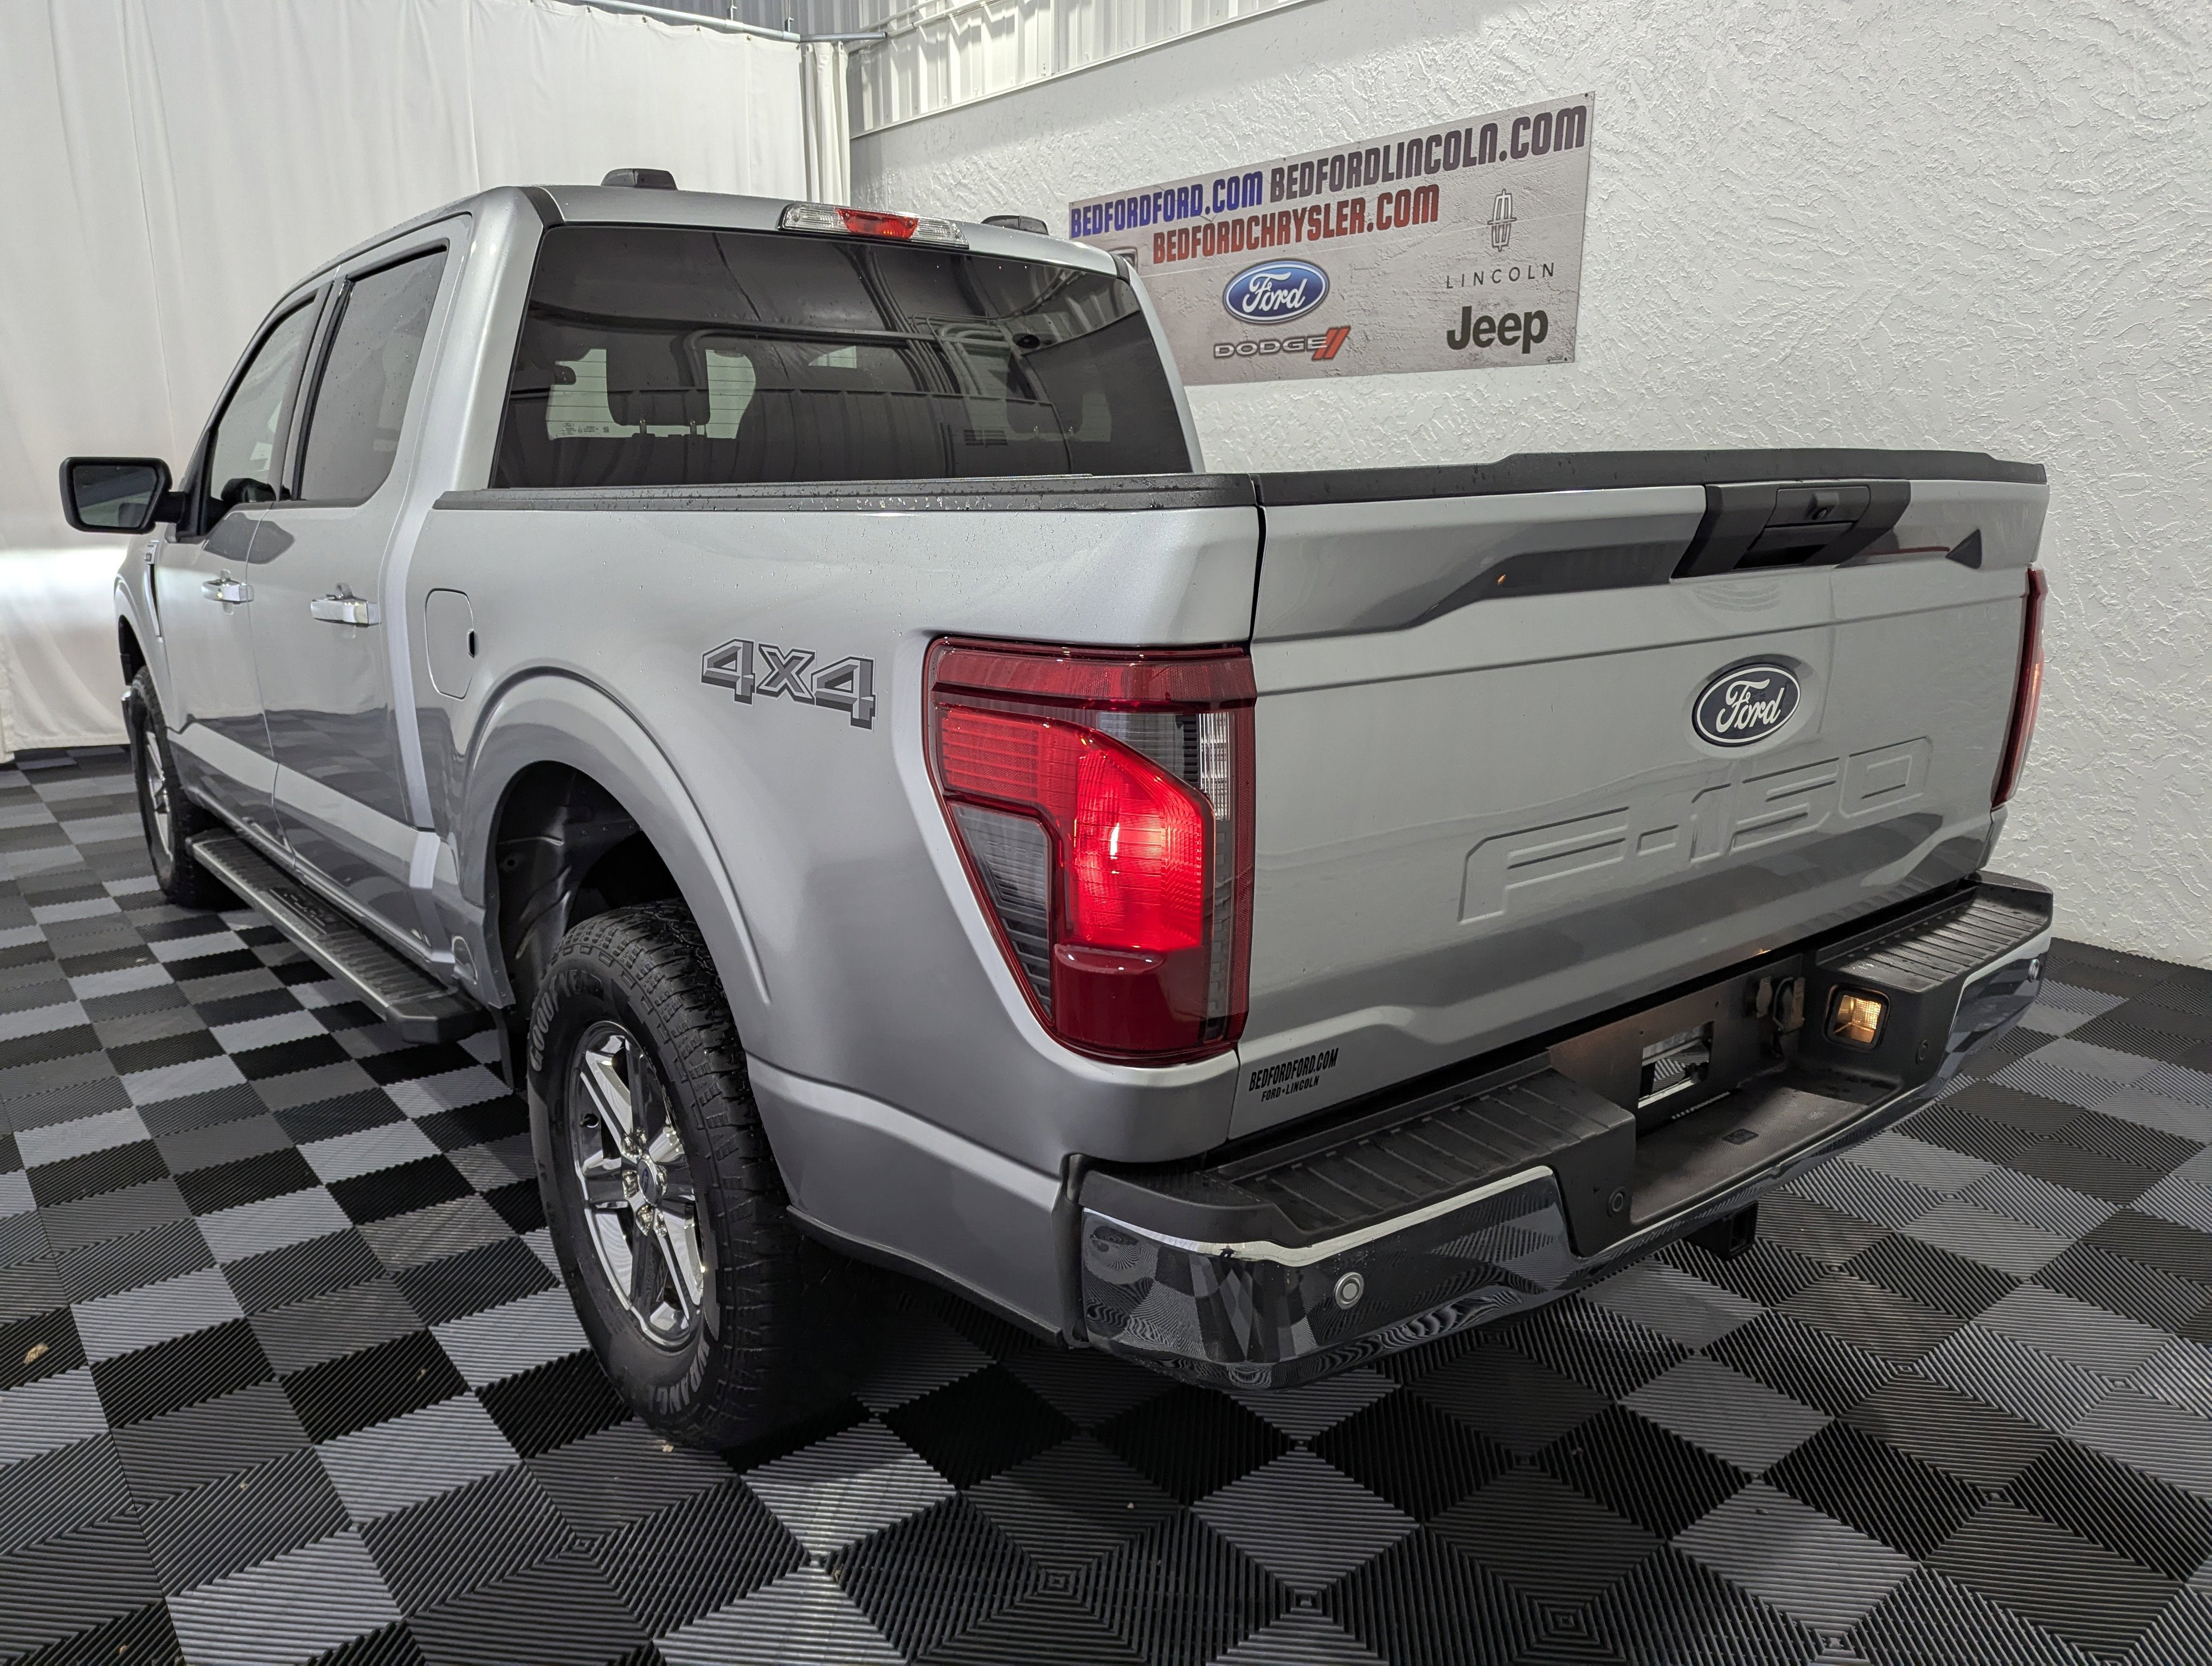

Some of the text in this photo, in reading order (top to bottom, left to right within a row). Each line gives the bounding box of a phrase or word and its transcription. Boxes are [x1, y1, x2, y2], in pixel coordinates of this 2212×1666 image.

[1071, 105, 1587, 239] BEDFORDFORD.COM BEDFORDLINCOLN.COM
[1153, 183, 1439, 265] BEDFORDCHRYSLER.COM
[1242, 272, 1308, 313] Ford
[1446, 262, 1554, 289] LINCOLN
[1214, 335, 1328, 358] DODGE
[1446, 305, 1548, 354] Jeep
[1716, 678, 1783, 732] Ford
[530, 970, 605, 1072] GOODYEAR
[1249, 1047, 1339, 1092] BEDFORDFORD.COM
